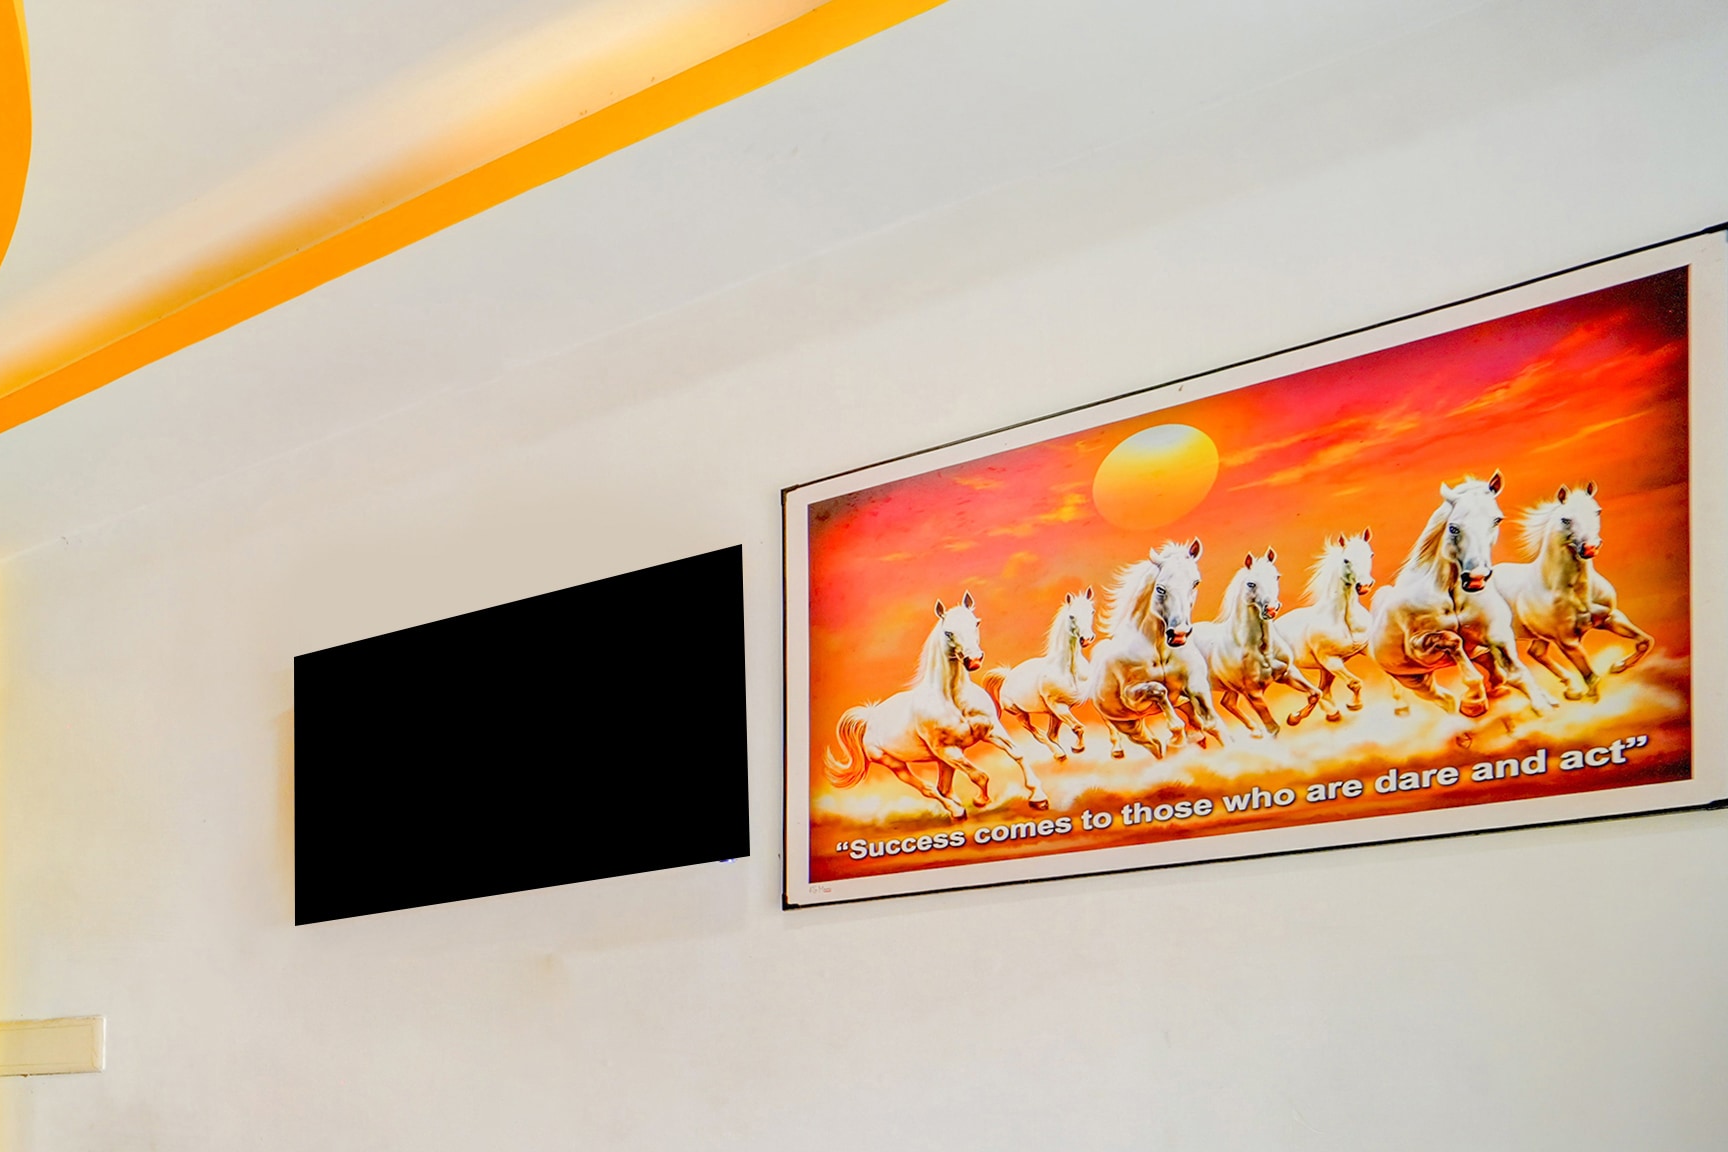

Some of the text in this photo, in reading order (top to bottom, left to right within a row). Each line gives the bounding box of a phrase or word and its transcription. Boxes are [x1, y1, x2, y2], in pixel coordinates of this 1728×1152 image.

[973, 816, 1072, 845] comes
[1080, 809, 1113, 831] to
[1121, 798, 1214, 826] those
[1222, 786, 1296, 813] who
[1305, 778, 1363, 803] are
[1374, 766, 1460, 795] dare
[1470, 749, 1547, 782] and
